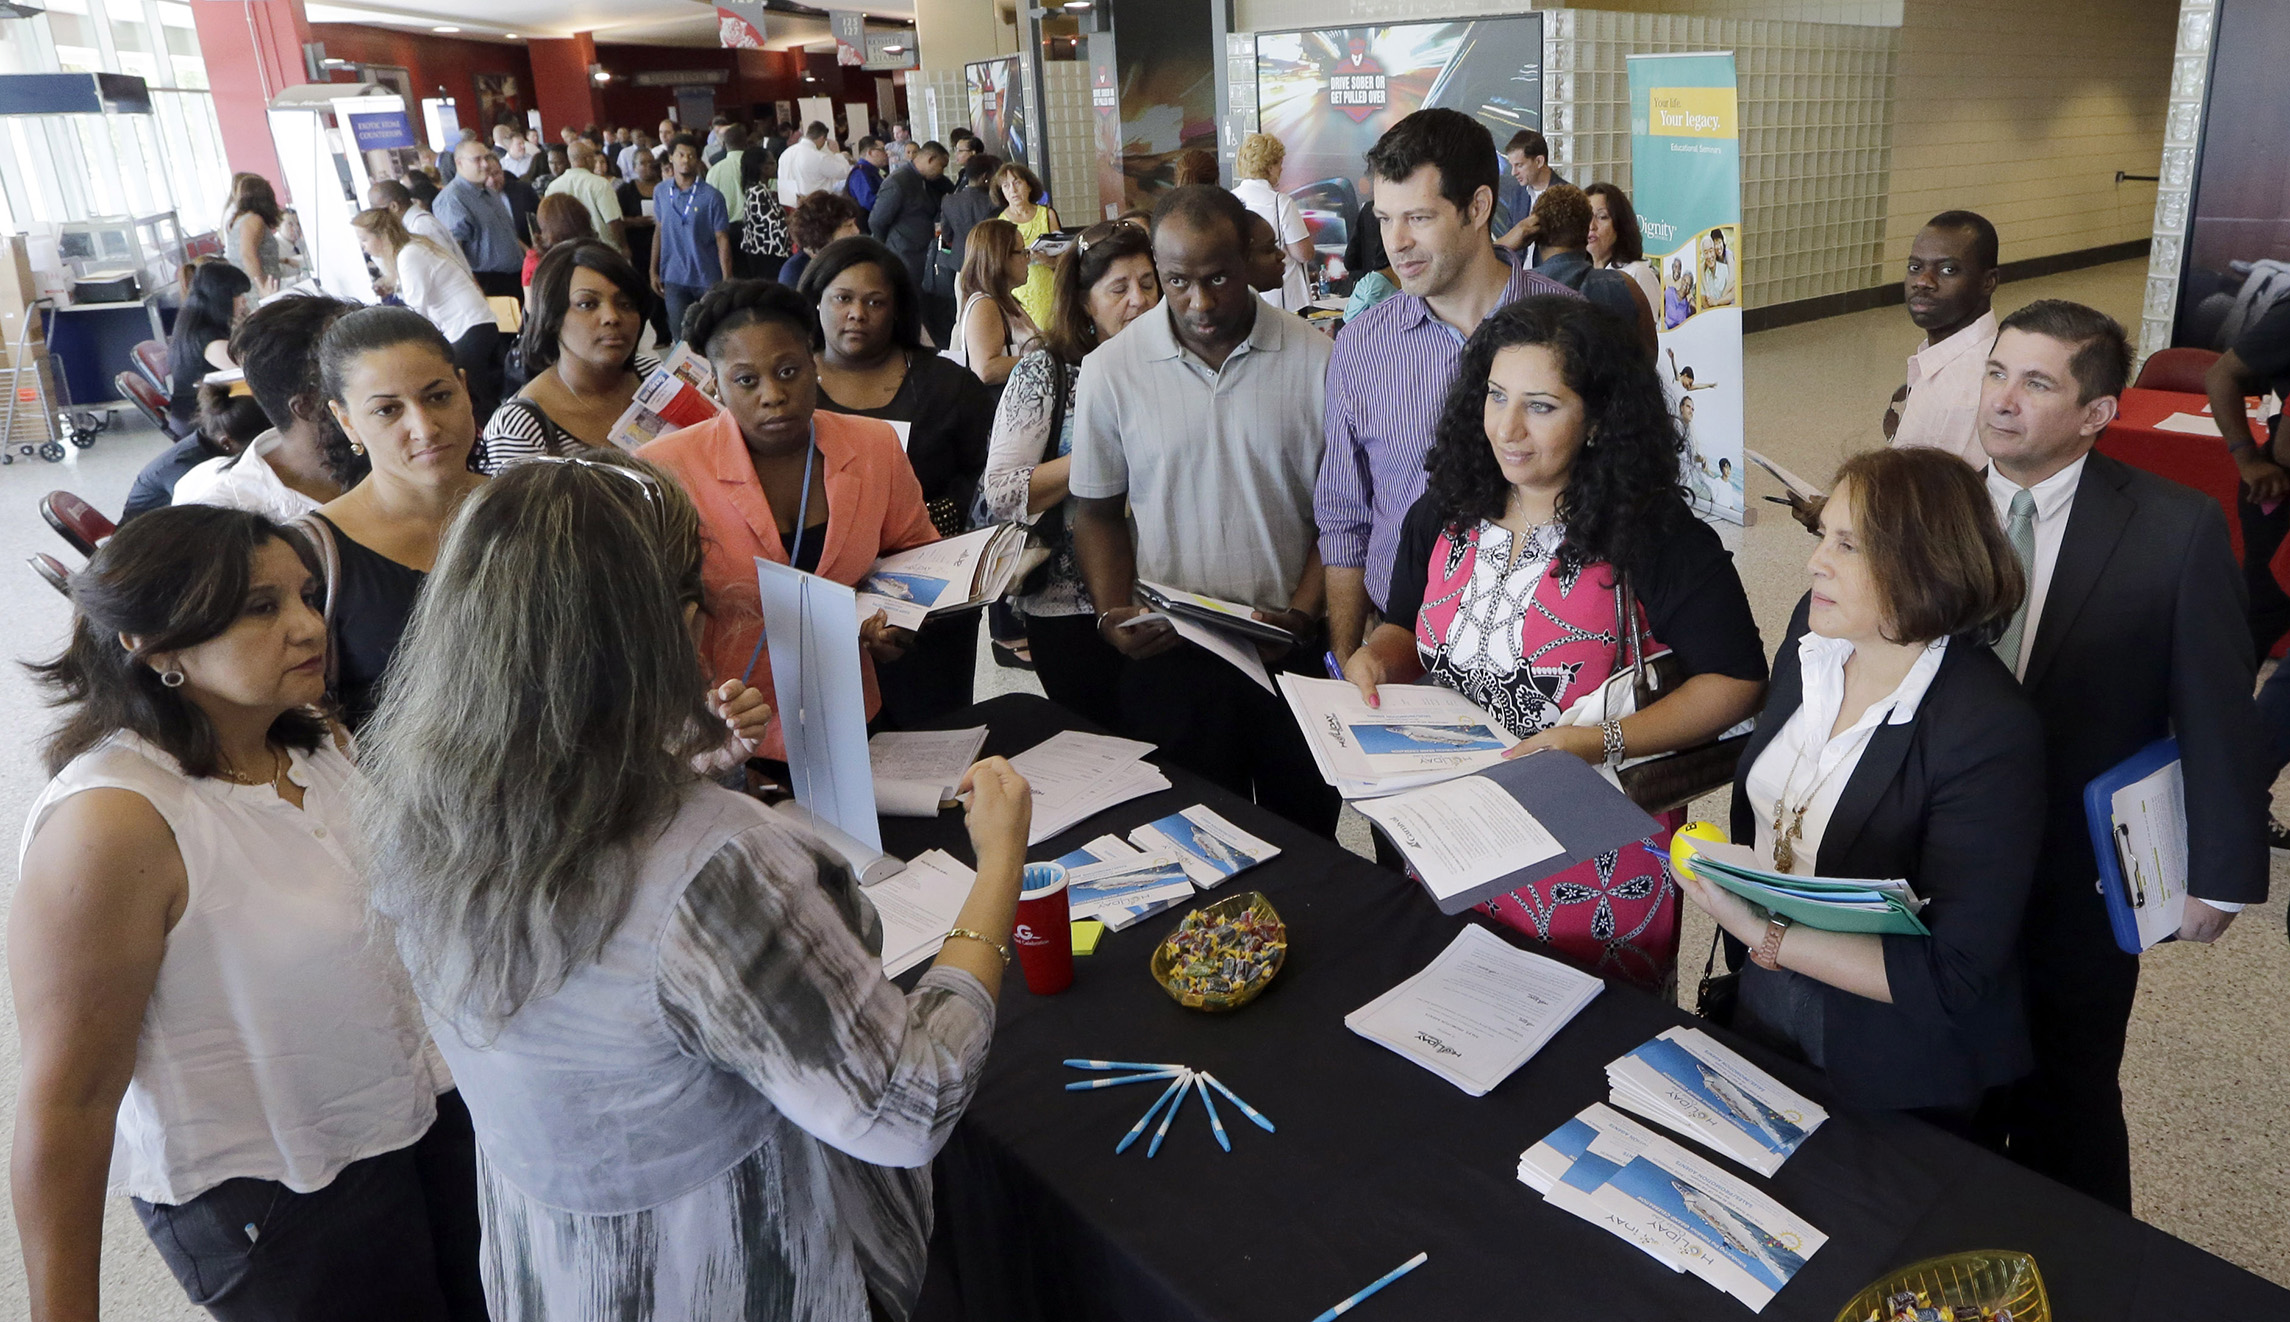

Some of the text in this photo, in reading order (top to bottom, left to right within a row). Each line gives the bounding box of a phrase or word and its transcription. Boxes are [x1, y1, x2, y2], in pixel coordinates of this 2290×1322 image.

[1330, 75, 1385, 90] DRIVE SOBER OR
[1330, 90, 1386, 104] GET PULLED OVER
[1654, 98, 1669, 108] Your
[1660, 110, 1720, 131] Your legacy.
[1671, 143, 1698, 153] Educational
[1636, 214, 1674, 242] Dignity
[1389, 815, 1415, 843] Carnival
[1675, 1159, 1697, 1176] AGENTS
[1698, 1173, 1753, 1209] SALES/PROMOTION
[1636, 1194, 1671, 1219] CELEBRATION
[1670, 1214, 1690, 1230] GRAND
